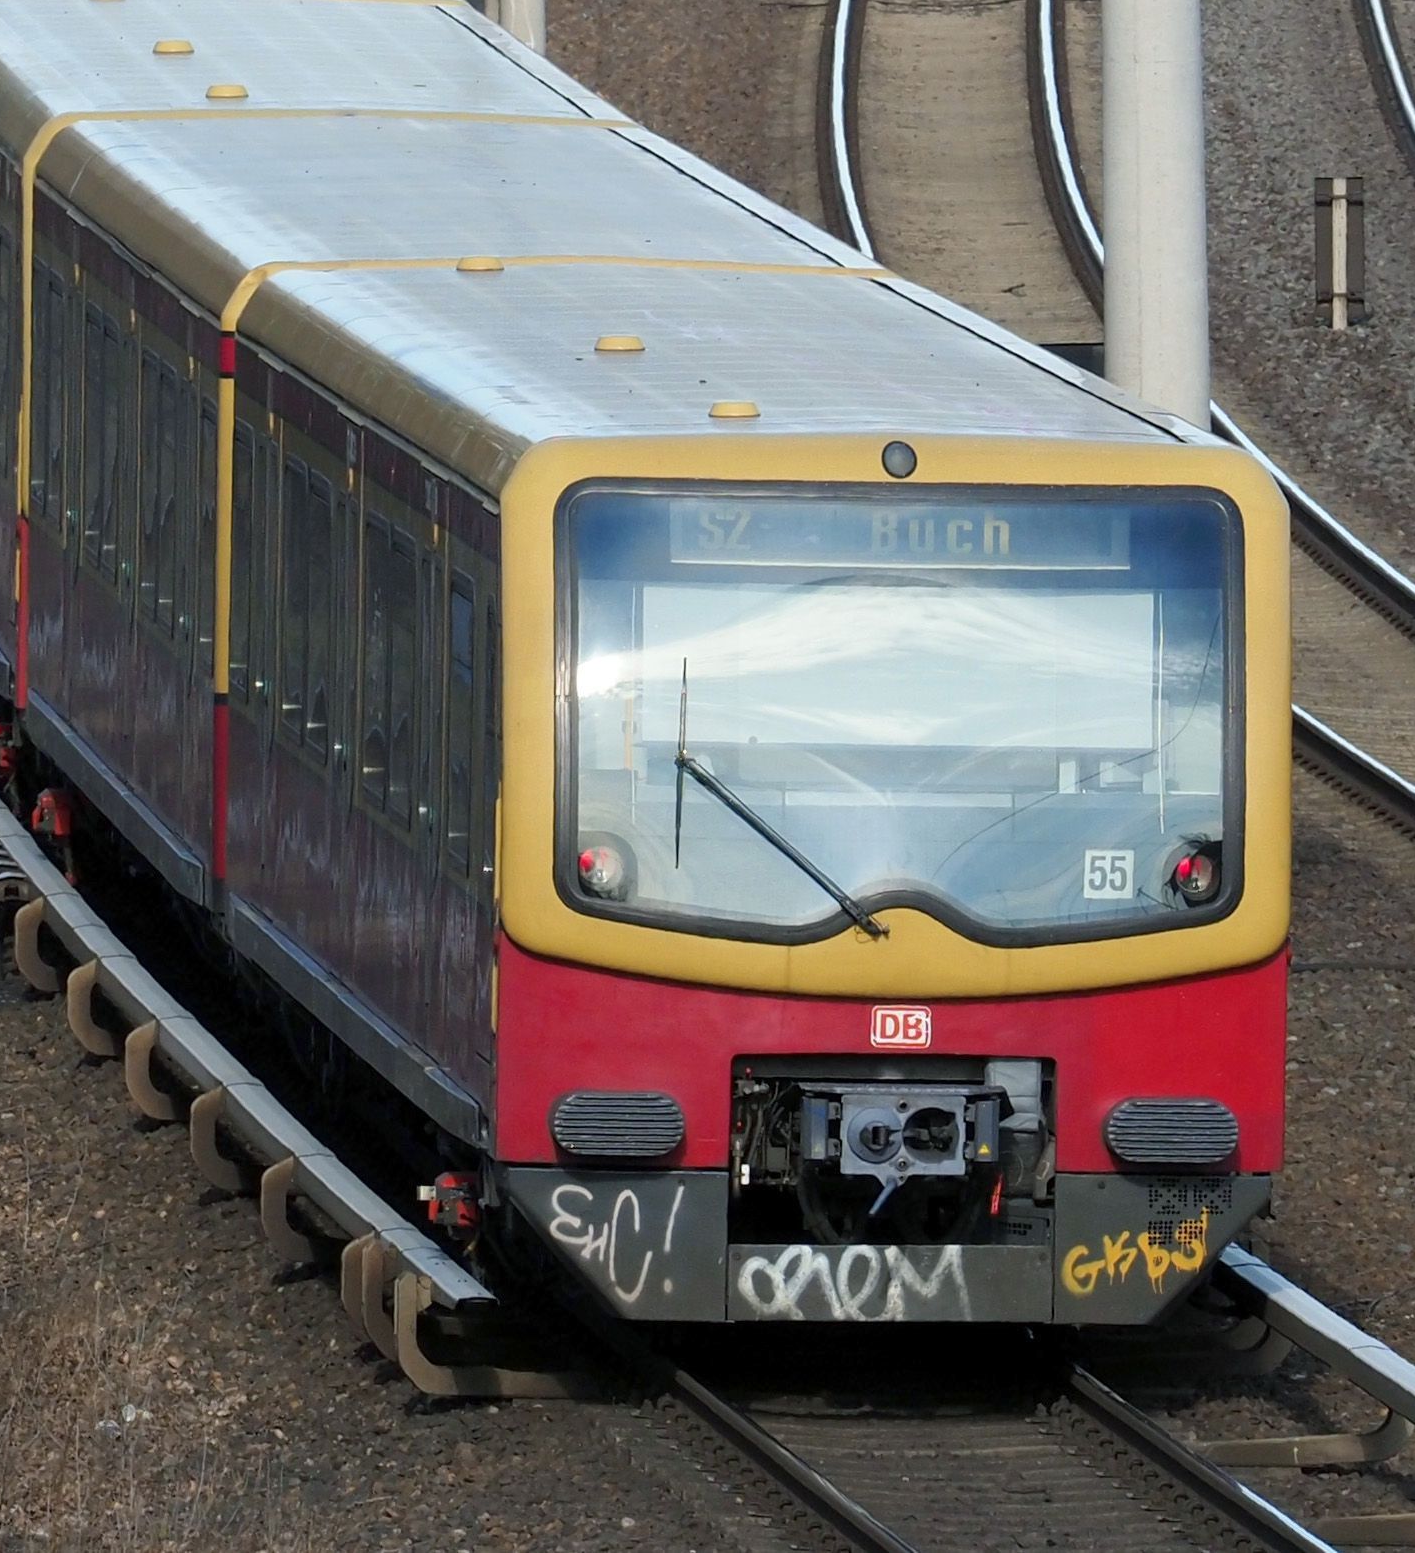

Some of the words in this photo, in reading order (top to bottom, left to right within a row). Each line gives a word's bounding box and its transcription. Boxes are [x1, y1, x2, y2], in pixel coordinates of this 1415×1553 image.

[698, 508, 751, 550] S2
[871, 508, 1010, 555] Buch
[1088, 855, 1128, 892] 55
[880, 1013, 923, 1041] DB
